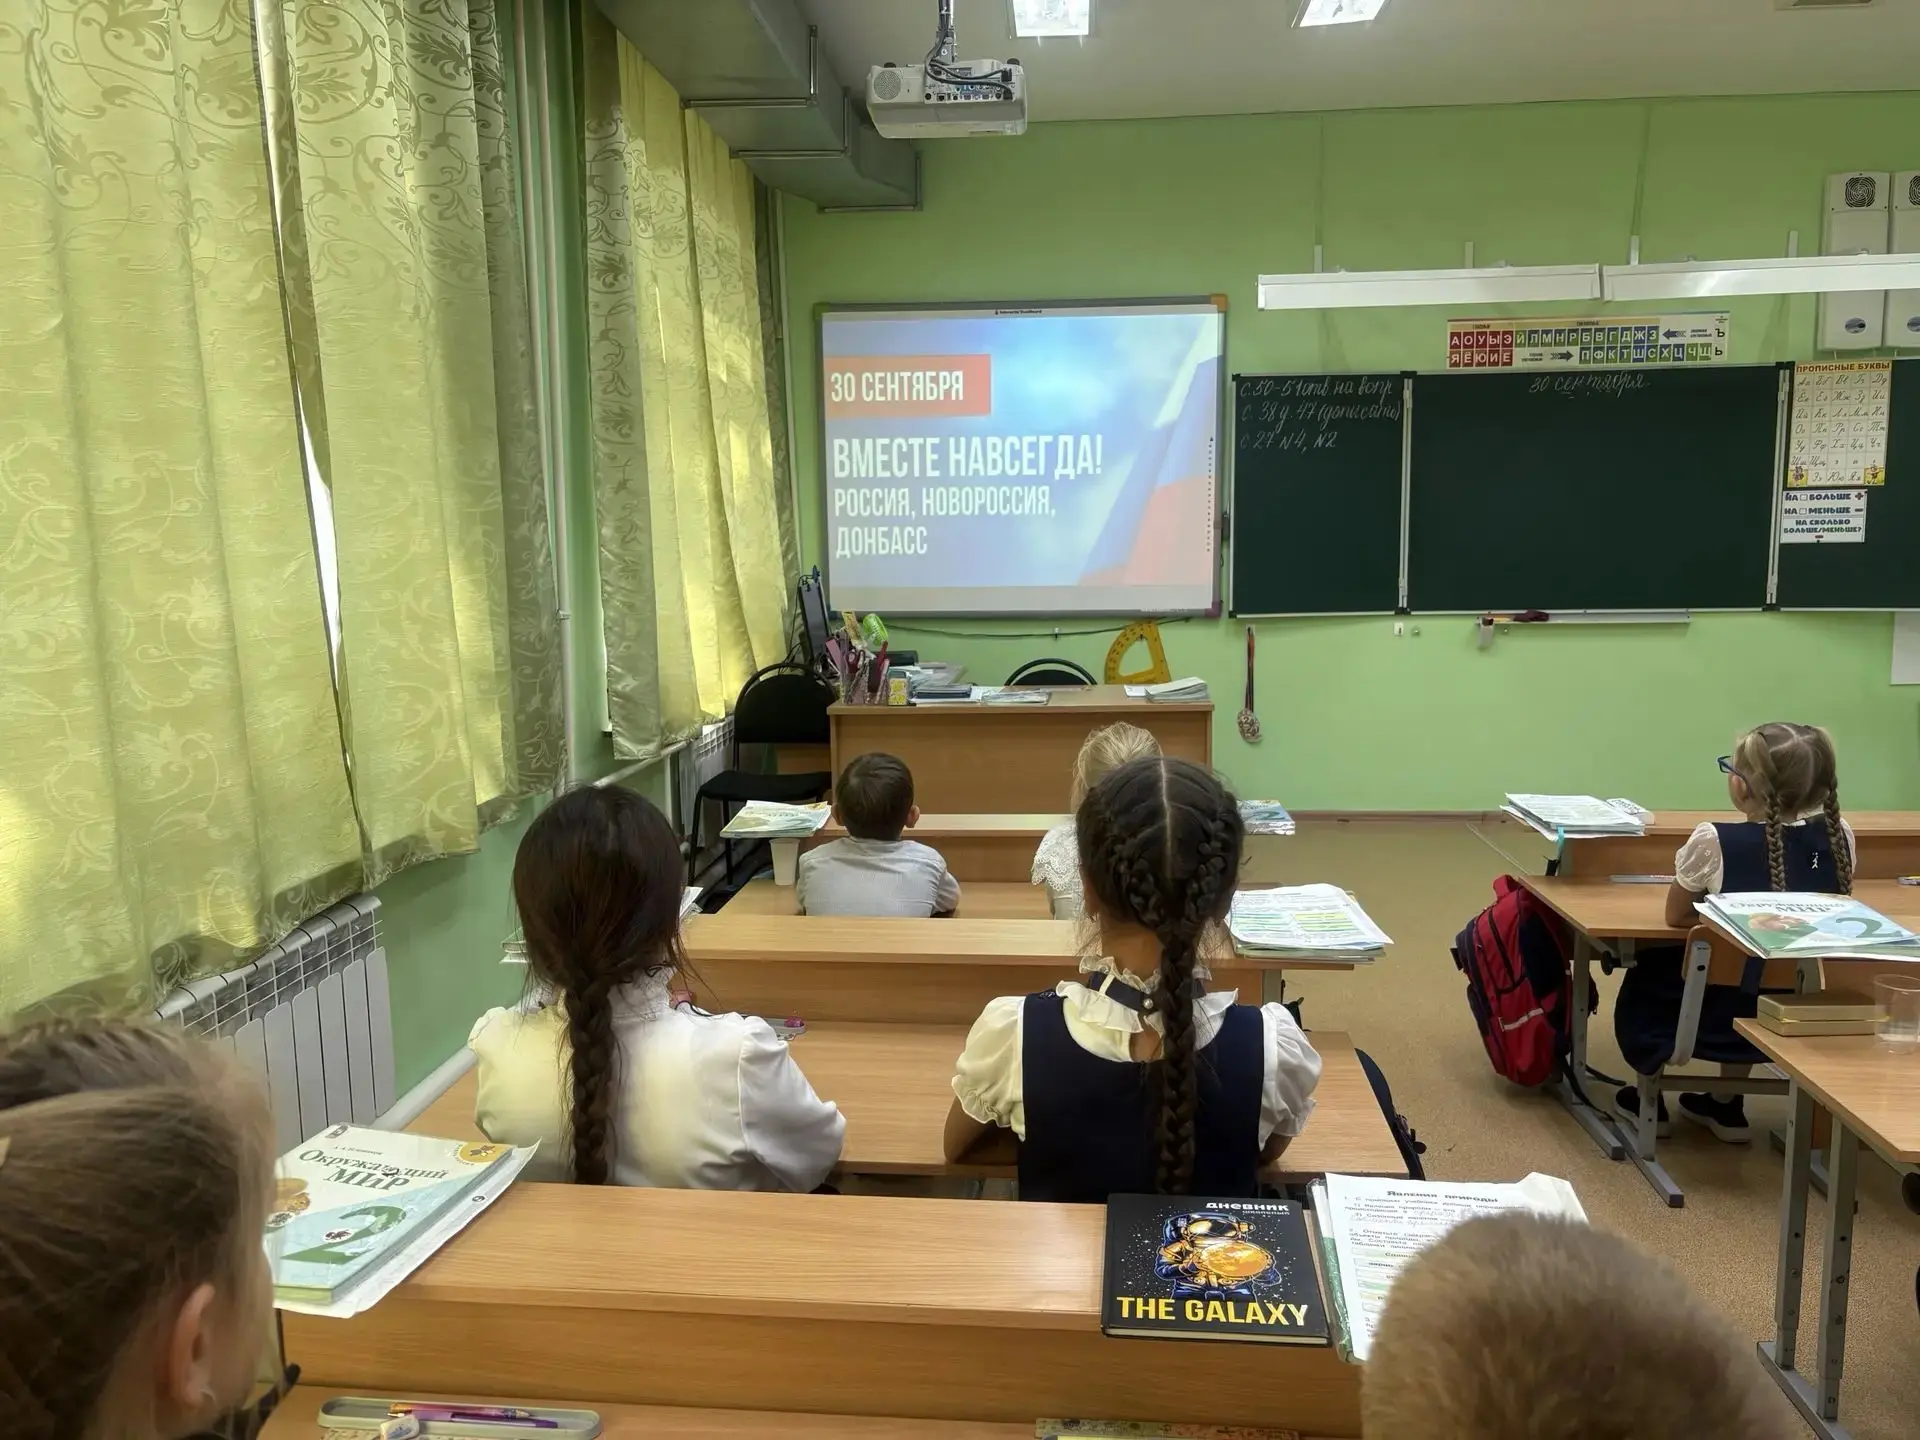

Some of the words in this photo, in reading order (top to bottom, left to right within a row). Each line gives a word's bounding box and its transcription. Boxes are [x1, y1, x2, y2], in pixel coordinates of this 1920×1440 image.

[1451, 336, 1459, 345] А
[1464, 336, 1473, 345] О
[1478, 336, 1485, 344] У
[1490, 335, 1499, 344] Ы
[1504, 335, 1511, 343] Э
[1517, 332, 1524, 343] Й
[1530, 335, 1537, 343] Л
[1542, 334, 1551, 342] М
[1556, 334, 1564, 342] Н
[1569, 333, 1576, 342] Р
[1582, 332, 1590, 341] Б
[1596, 332, 1603, 340] В
[1610, 332, 1616, 340] Г
[1622, 331, 1630, 341] Д
[1634, 331, 1644, 339] Ж
[1649, 331, 1656, 339] З
[1715, 329, 1725, 337] Ъ
[1451, 355, 1459, 363] Я
[1464, 352, 1471, 363] Ё
[1476, 353, 1486, 363] Ю
[1490, 353, 1498, 362] И
[1503, 353, 1511, 362] Е
[1581, 351, 1589, 359] П
[1594, 350, 1603, 359] Ф
[1608, 350, 1616, 358] К
[1621, 350, 1628, 358] Т
[1634, 349, 1644, 358] Ш
[1648, 349, 1655, 357] С
[1661, 349, 1669, 357] Х
[1675, 348, 1683, 358] Ц
[1688, 347, 1695, 355] Ч
[1700, 346, 1711, 358] Щ
[1715, 347, 1722, 355] Ь
[1797, 364, 1854, 372] ПРОПИСНЫЕ
[1858, 362, 1890, 370] БУКВЫ
[831, 372, 855, 402] 30
[862, 370, 964, 402] СЕНТЯБРЯ
[1529, 376, 1550, 392] 30
[1259, 401, 1278, 422] 38
[833, 437, 940, 479] ВМЕСТЕ
[949, 434, 1103, 480] НАВСЕГДА!
[835, 487, 916, 520] РОССИЯ,
[923, 485, 1056, 518] НОВОРОССИЯ,
[836, 525, 928, 559] ДОНБАСС
[1836, 917, 1903, 938] 2
[281, 1205, 407, 1265] 2
[1116, 1297, 1176, 1320] THE
[1185, 1299, 1308, 1326] GALAXY
